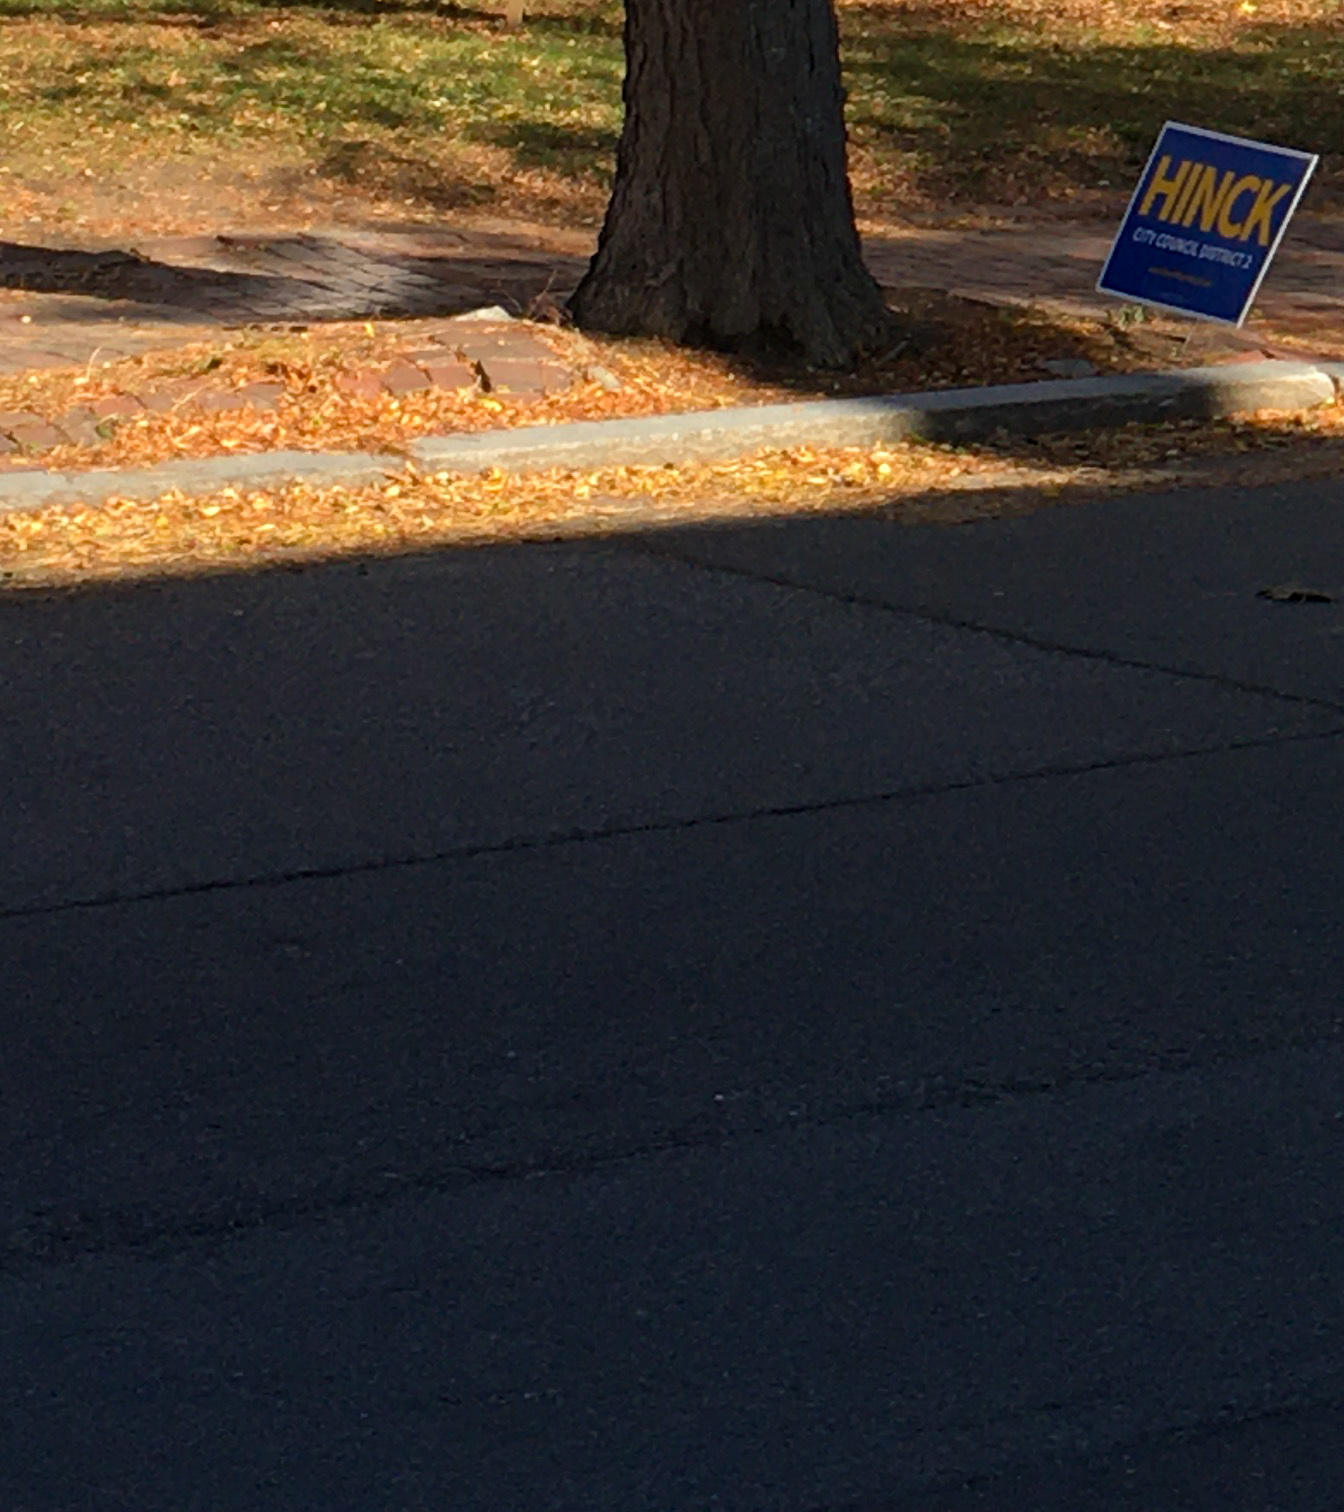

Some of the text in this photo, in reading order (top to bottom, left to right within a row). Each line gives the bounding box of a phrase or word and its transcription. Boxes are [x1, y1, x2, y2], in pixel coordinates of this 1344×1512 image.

[1138, 155, 1292, 246] HINCK
[1133, 226, 1157, 245] CITY
[1155, 233, 1199, 257] COUNCIL
[1199, 244, 1246, 267] DISTRICT
